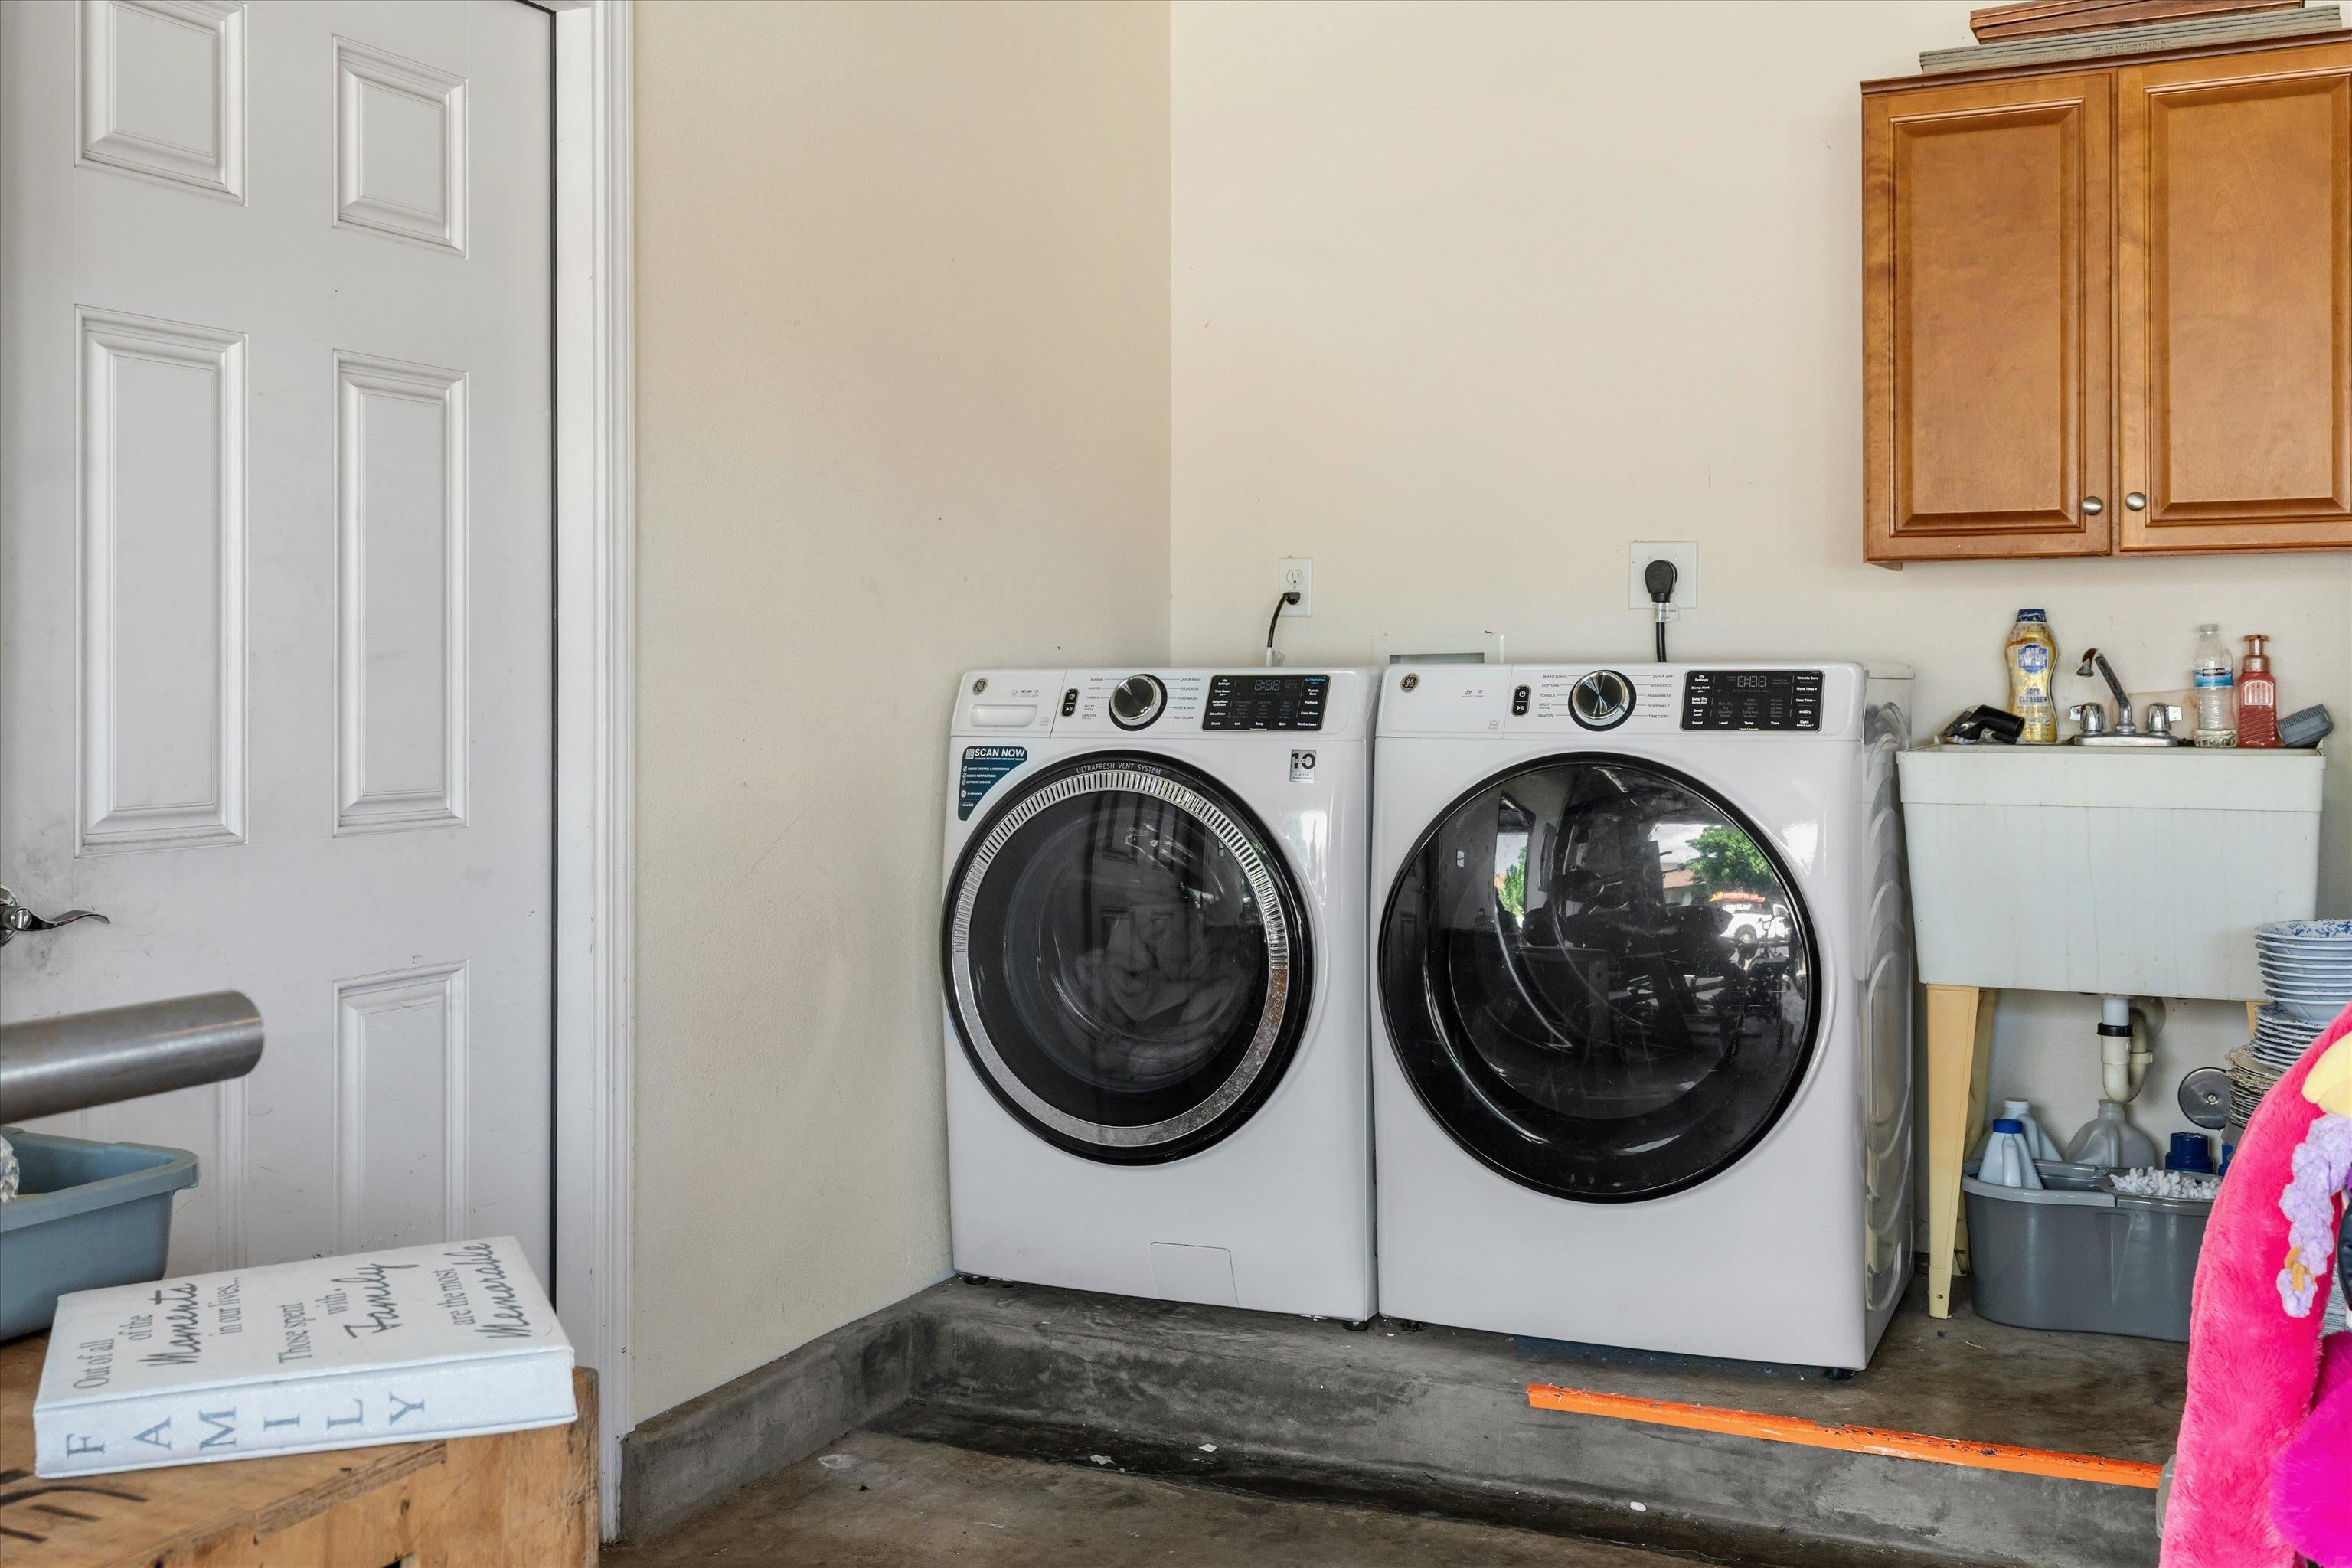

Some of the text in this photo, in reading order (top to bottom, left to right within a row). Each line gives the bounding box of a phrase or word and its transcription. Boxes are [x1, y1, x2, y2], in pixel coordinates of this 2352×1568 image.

[975, 748, 1025, 757] SCAN NOW
[1076, 763, 1115, 773] ULTRAFRESH
[1137, 764, 1161, 775] SYSTEM
[1292, 753, 1315, 769] 10
[315, 1292, 349, 1315] with
[331, 1263, 420, 1338] Family
[433, 1269, 476, 1326] are the most
[443, 1243, 532, 1338] Memorable
[118, 1314, 153, 1340] of the
[136, 1283, 202, 1367] Moments
[208, 1323, 243, 1337] in
[219, 1307, 242, 1323] our
[277, 1302, 316, 1364] Those spent
[72, 1338, 115, 1389] Out of all
[66, 1392, 425, 1458] FAMILY
